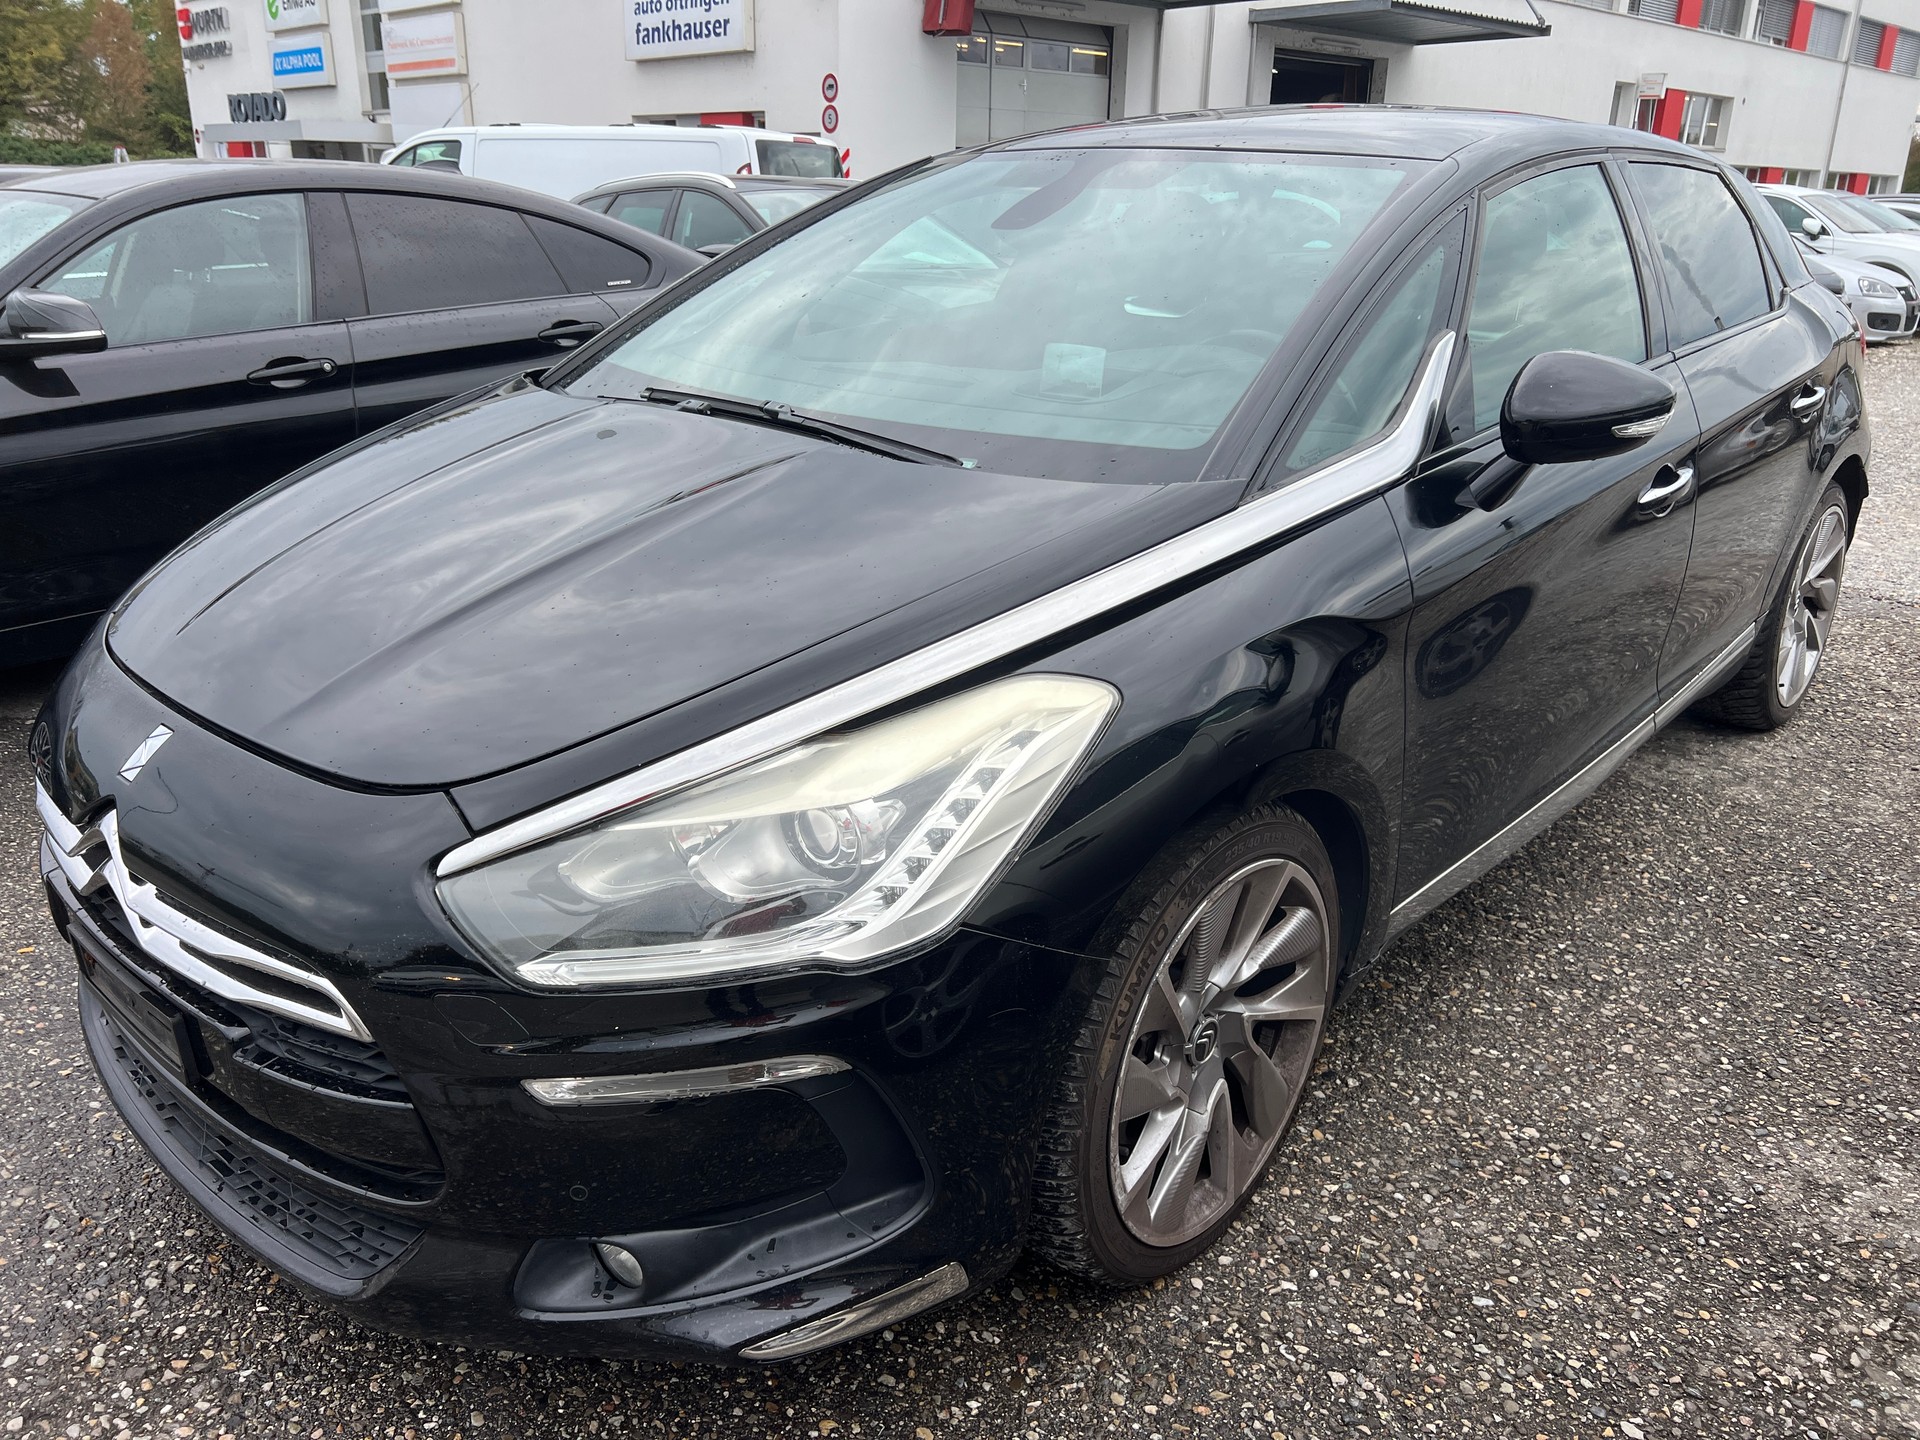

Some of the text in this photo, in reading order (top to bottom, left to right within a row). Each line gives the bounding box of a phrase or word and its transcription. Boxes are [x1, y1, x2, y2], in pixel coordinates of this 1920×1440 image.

[634, 0, 662, 16] auto
[635, 17, 730, 45] fankhauser
[302, 52, 322, 67] POOL
[1109, 923, 1169, 1041] KUMHO
